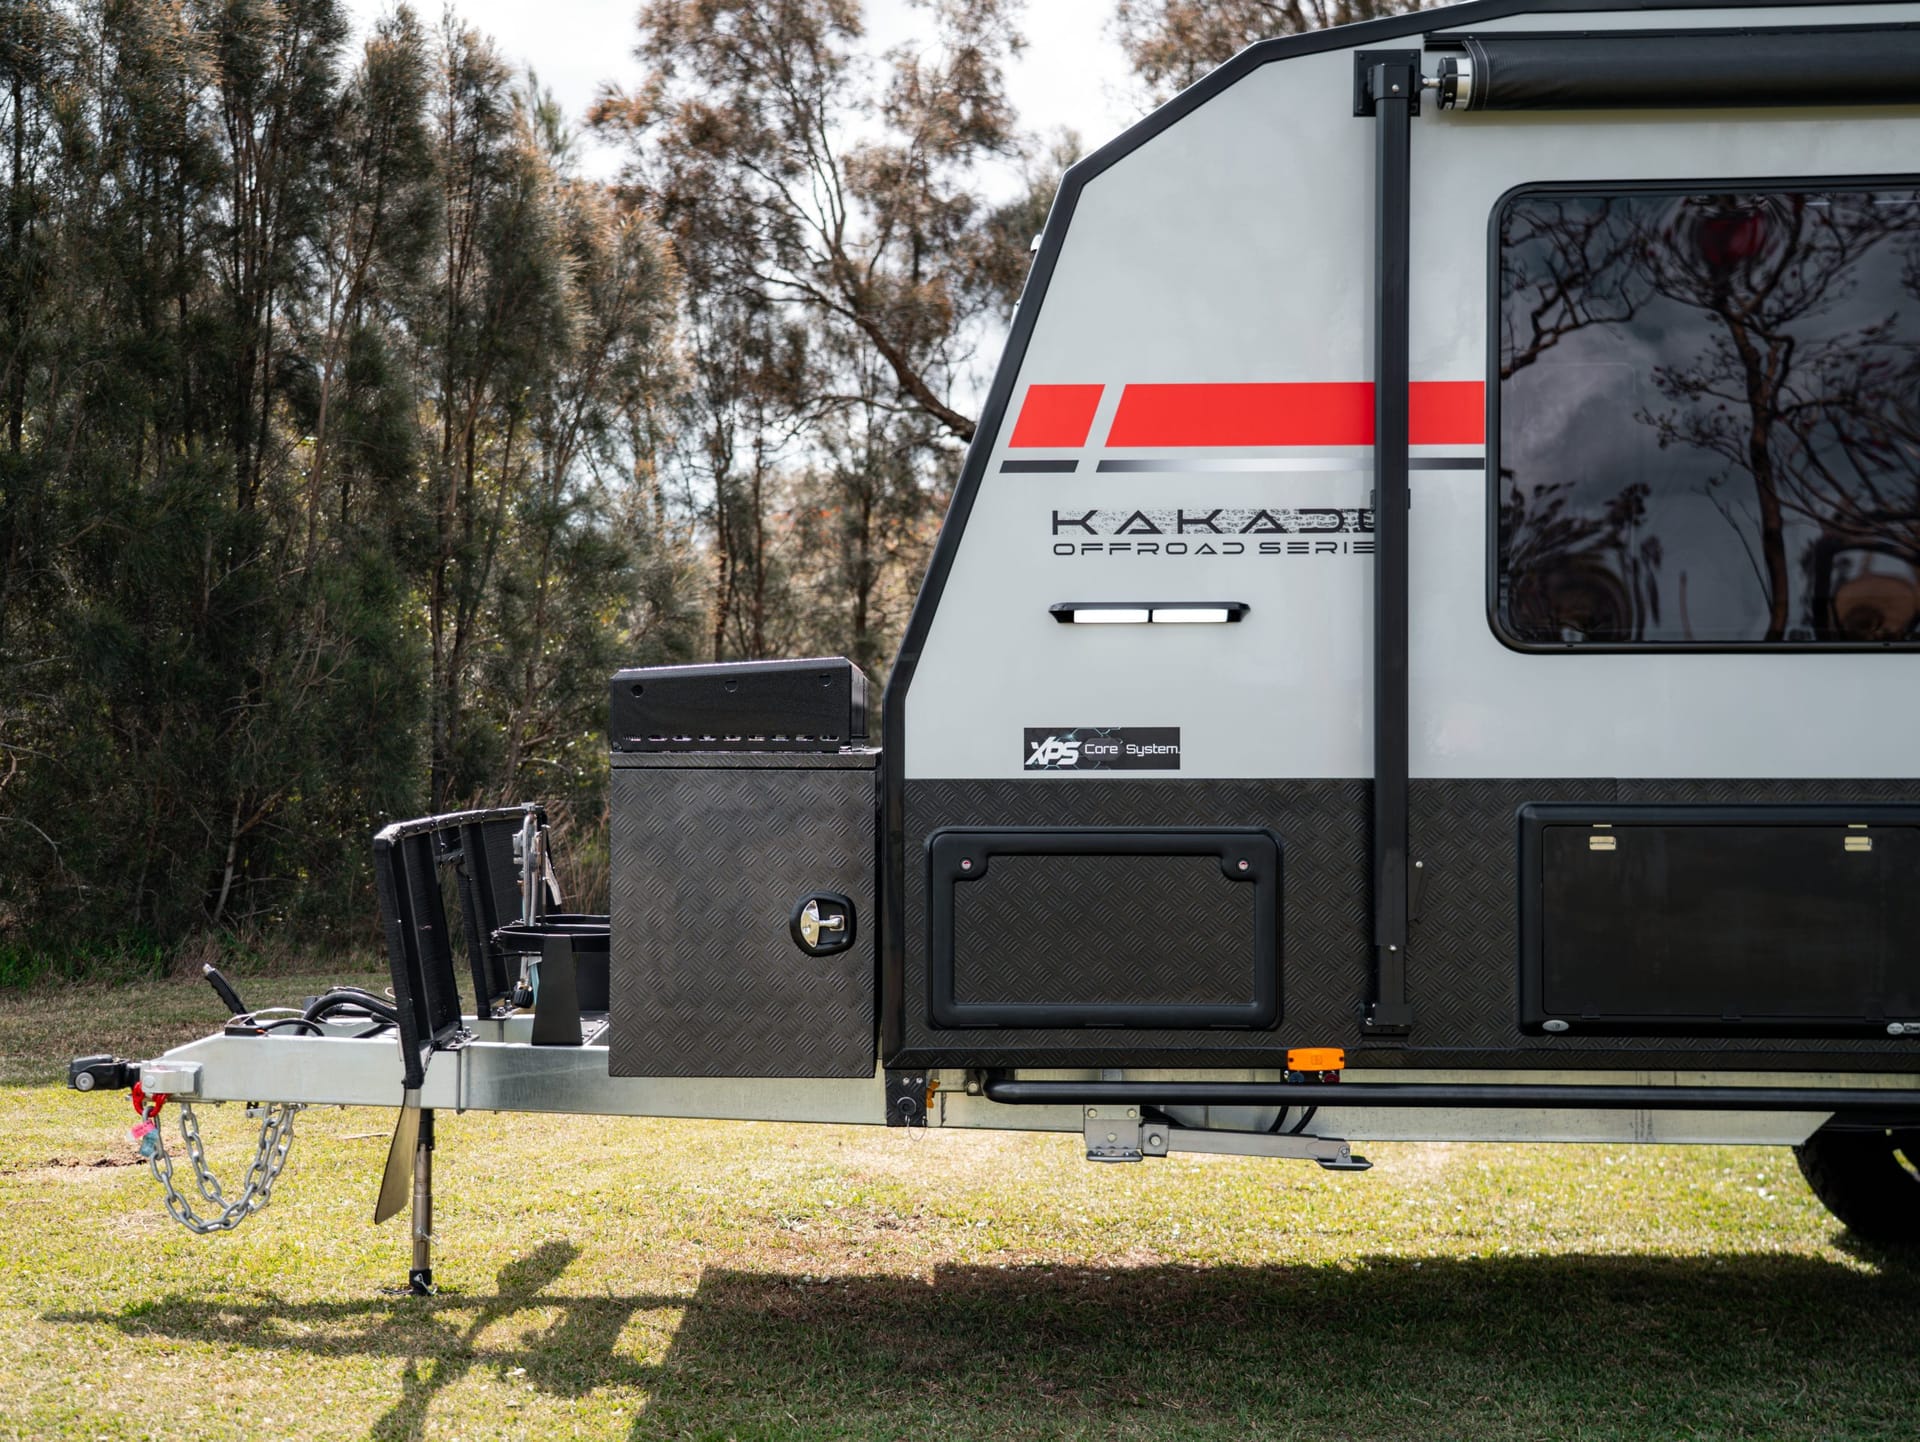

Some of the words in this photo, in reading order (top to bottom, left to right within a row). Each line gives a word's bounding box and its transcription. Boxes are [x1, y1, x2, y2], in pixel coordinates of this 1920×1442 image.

[1053, 541, 1245, 555] OFFROAD
[1258, 540, 1375, 555] SERIE
[1025, 736, 1082, 765] XPS
[1084, 743, 1118, 755] Core
